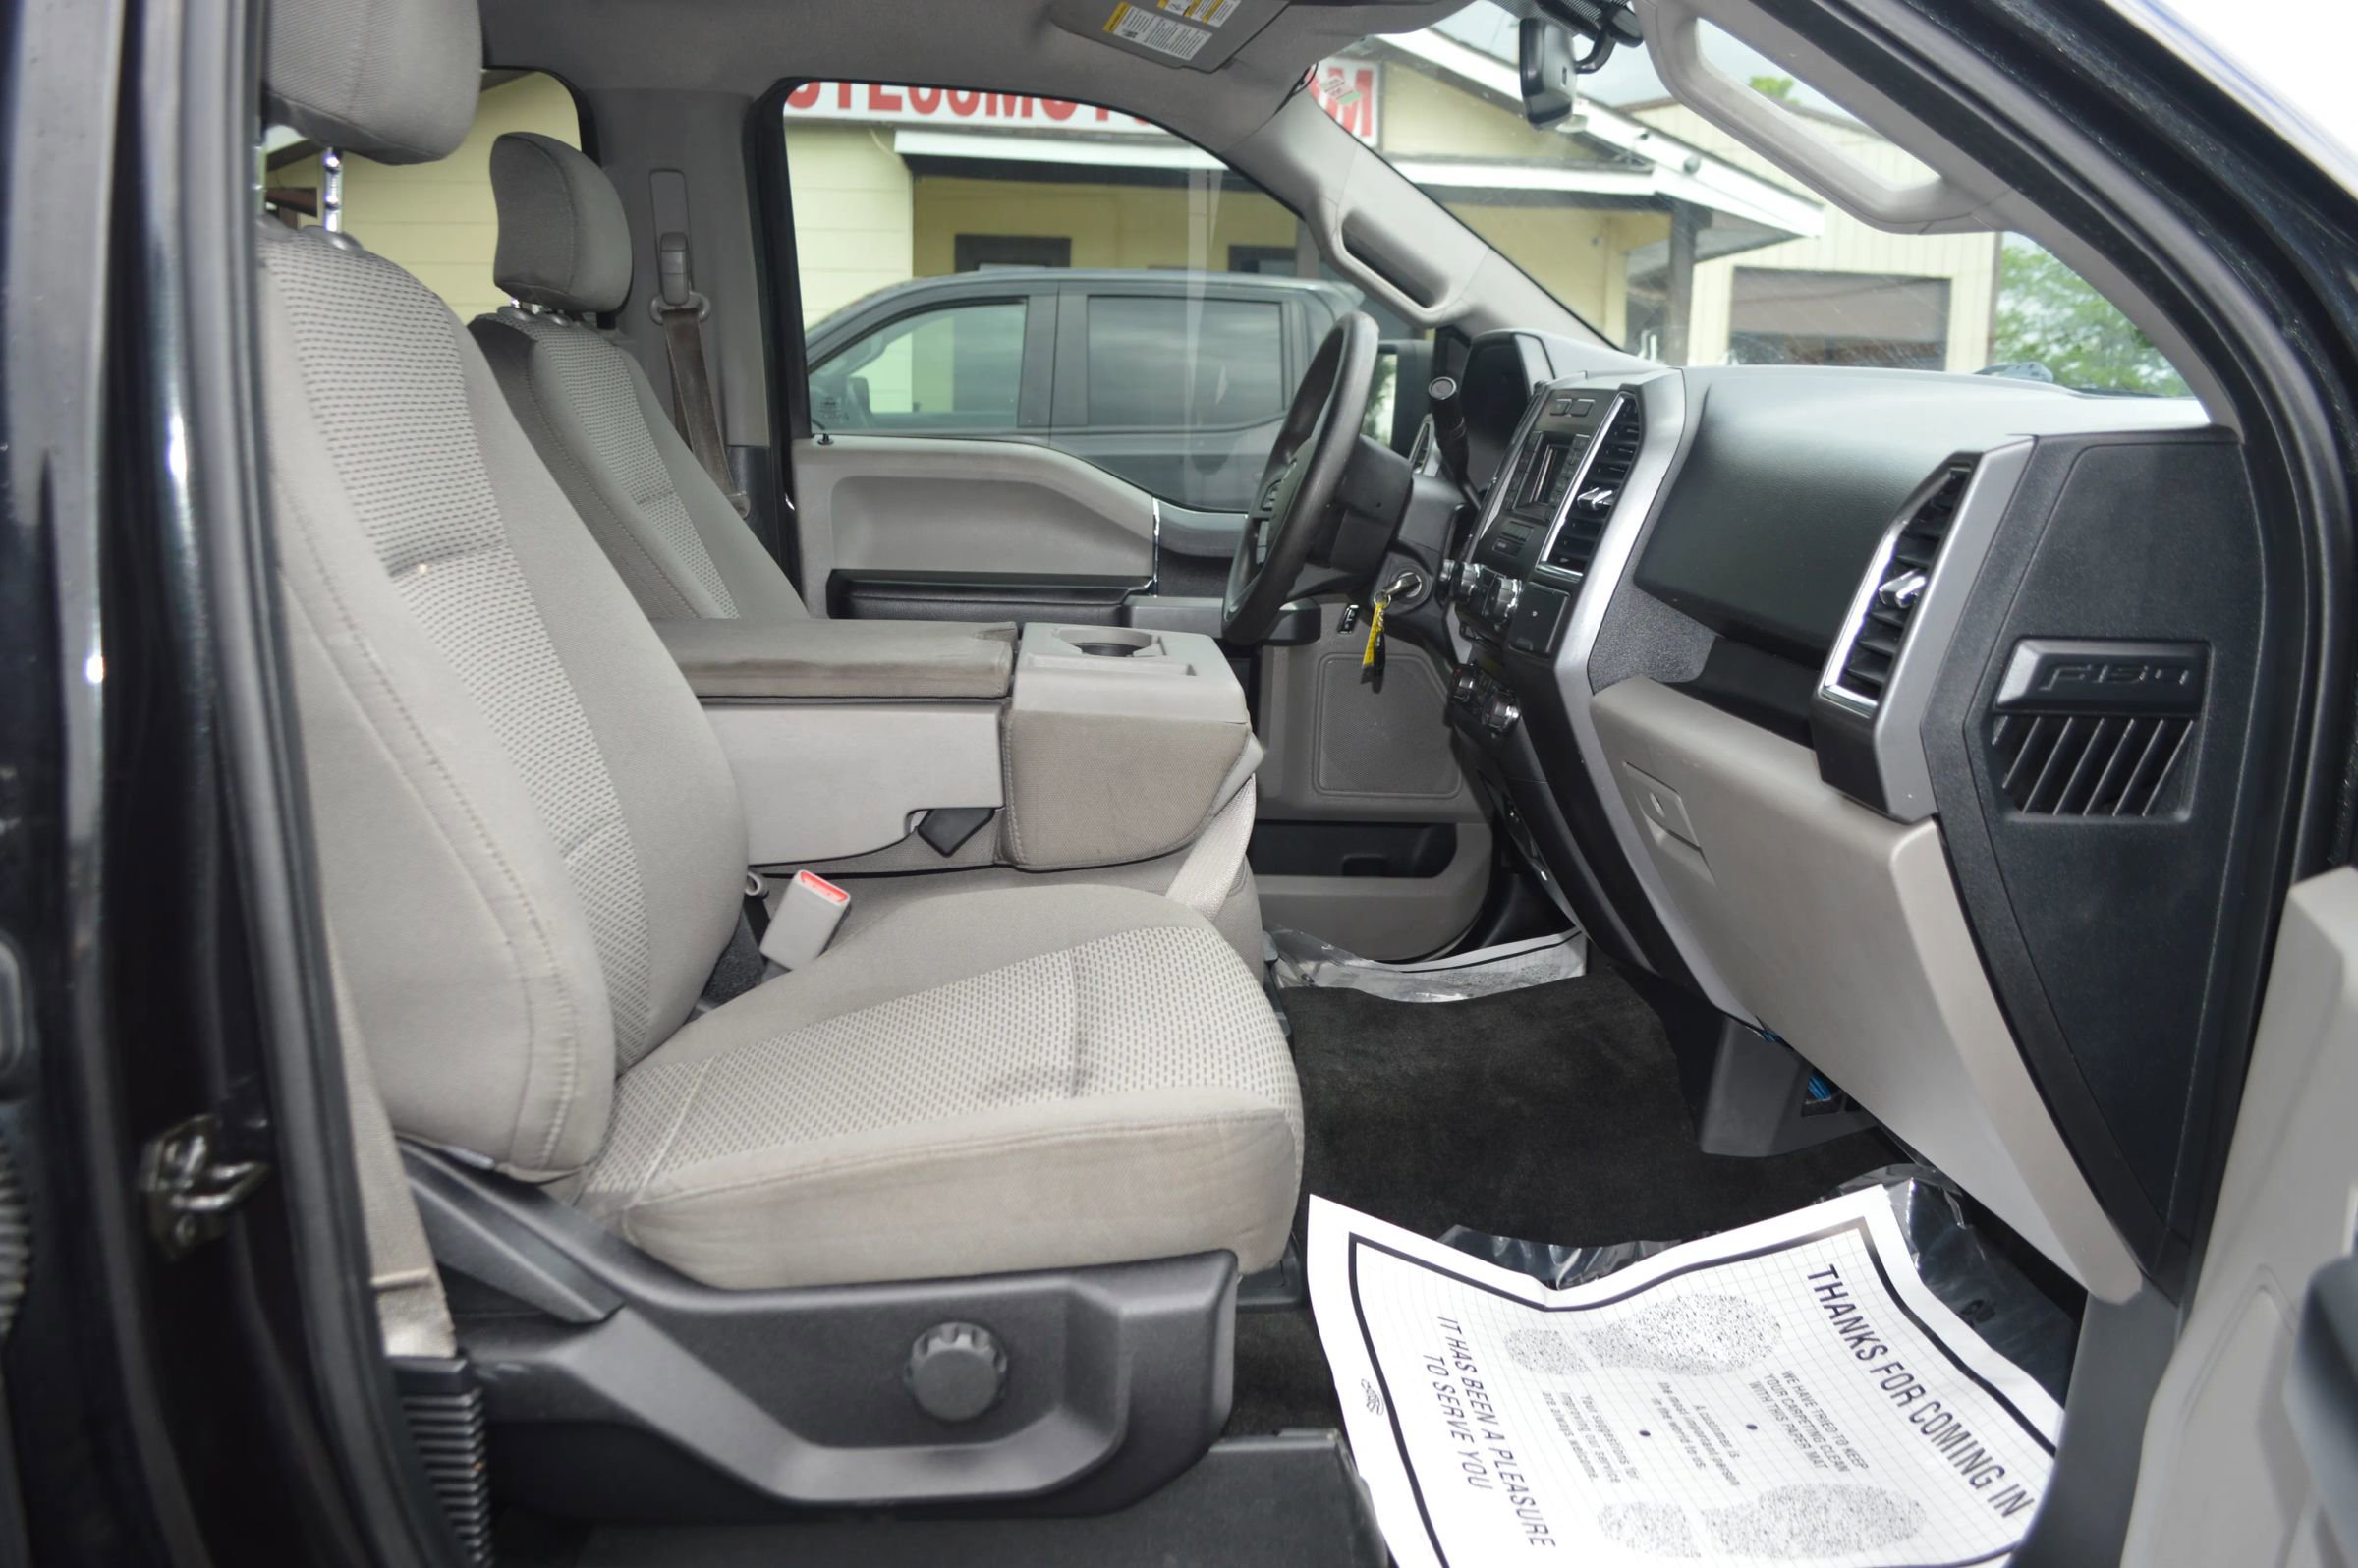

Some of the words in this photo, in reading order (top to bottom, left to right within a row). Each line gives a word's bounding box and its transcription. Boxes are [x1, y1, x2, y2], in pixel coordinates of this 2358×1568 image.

[1437, 1316, 1462, 1335] IT
[1423, 1354, 1449, 1376] TO
[1445, 1336, 1478, 1373] HAS
[1432, 1381, 1475, 1443] SERVE
[1461, 1376, 1498, 1425] BEEN
[1543, 1391, 1556, 1406] are
[1550, 1408, 1574, 1437] always
[1808, 1264, 1888, 1362] THANKS
[1869, 1361, 1927, 1408] FOR
[1909, 1401, 2005, 1490] COMING
[1987, 1484, 2035, 1518] IN
[1481, 1428, 1505, 1440] A
[1560, 1392, 1591, 1431] improving
[1585, 1434, 1600, 1449] our
[1595, 1451, 1621, 1484] service
[1579, 1394, 1598, 1413] Your
[1592, 1415, 1630, 1465] suggestions
[1658, 1407, 1672, 1420] the
[1668, 1421, 1691, 1443] world
[1658, 1382, 1672, 1394] the
[1668, 1396, 1689, 1415] most
[1684, 1416, 1719, 1455] important
[1712, 1457, 1740, 1486] person
[1699, 1412, 1732, 1448] customer
[1749, 1381, 1774, 1403] WITH
[1767, 1403, 1789, 1422] THIS
[1782, 1423, 1812, 1449] PAPER
[1805, 1451, 1828, 1469] MAT
[1765, 1373, 1788, 1397] YOUR
[1781, 1397, 1826, 1443] CARPETING
[1820, 1444, 1850, 1472] CLEAN
[1781, 1371, 1800, 1385] WE
[1792, 1385, 1818, 1407] HAVE
[1812, 1408, 1838, 1433] TRIED
[1832, 1434, 1849, 1446] TO
[1843, 1447, 1869, 1469] KEEP
[1457, 1450, 1493, 1490] YOU
[1488, 1447, 1556, 1547] PLEASURE
